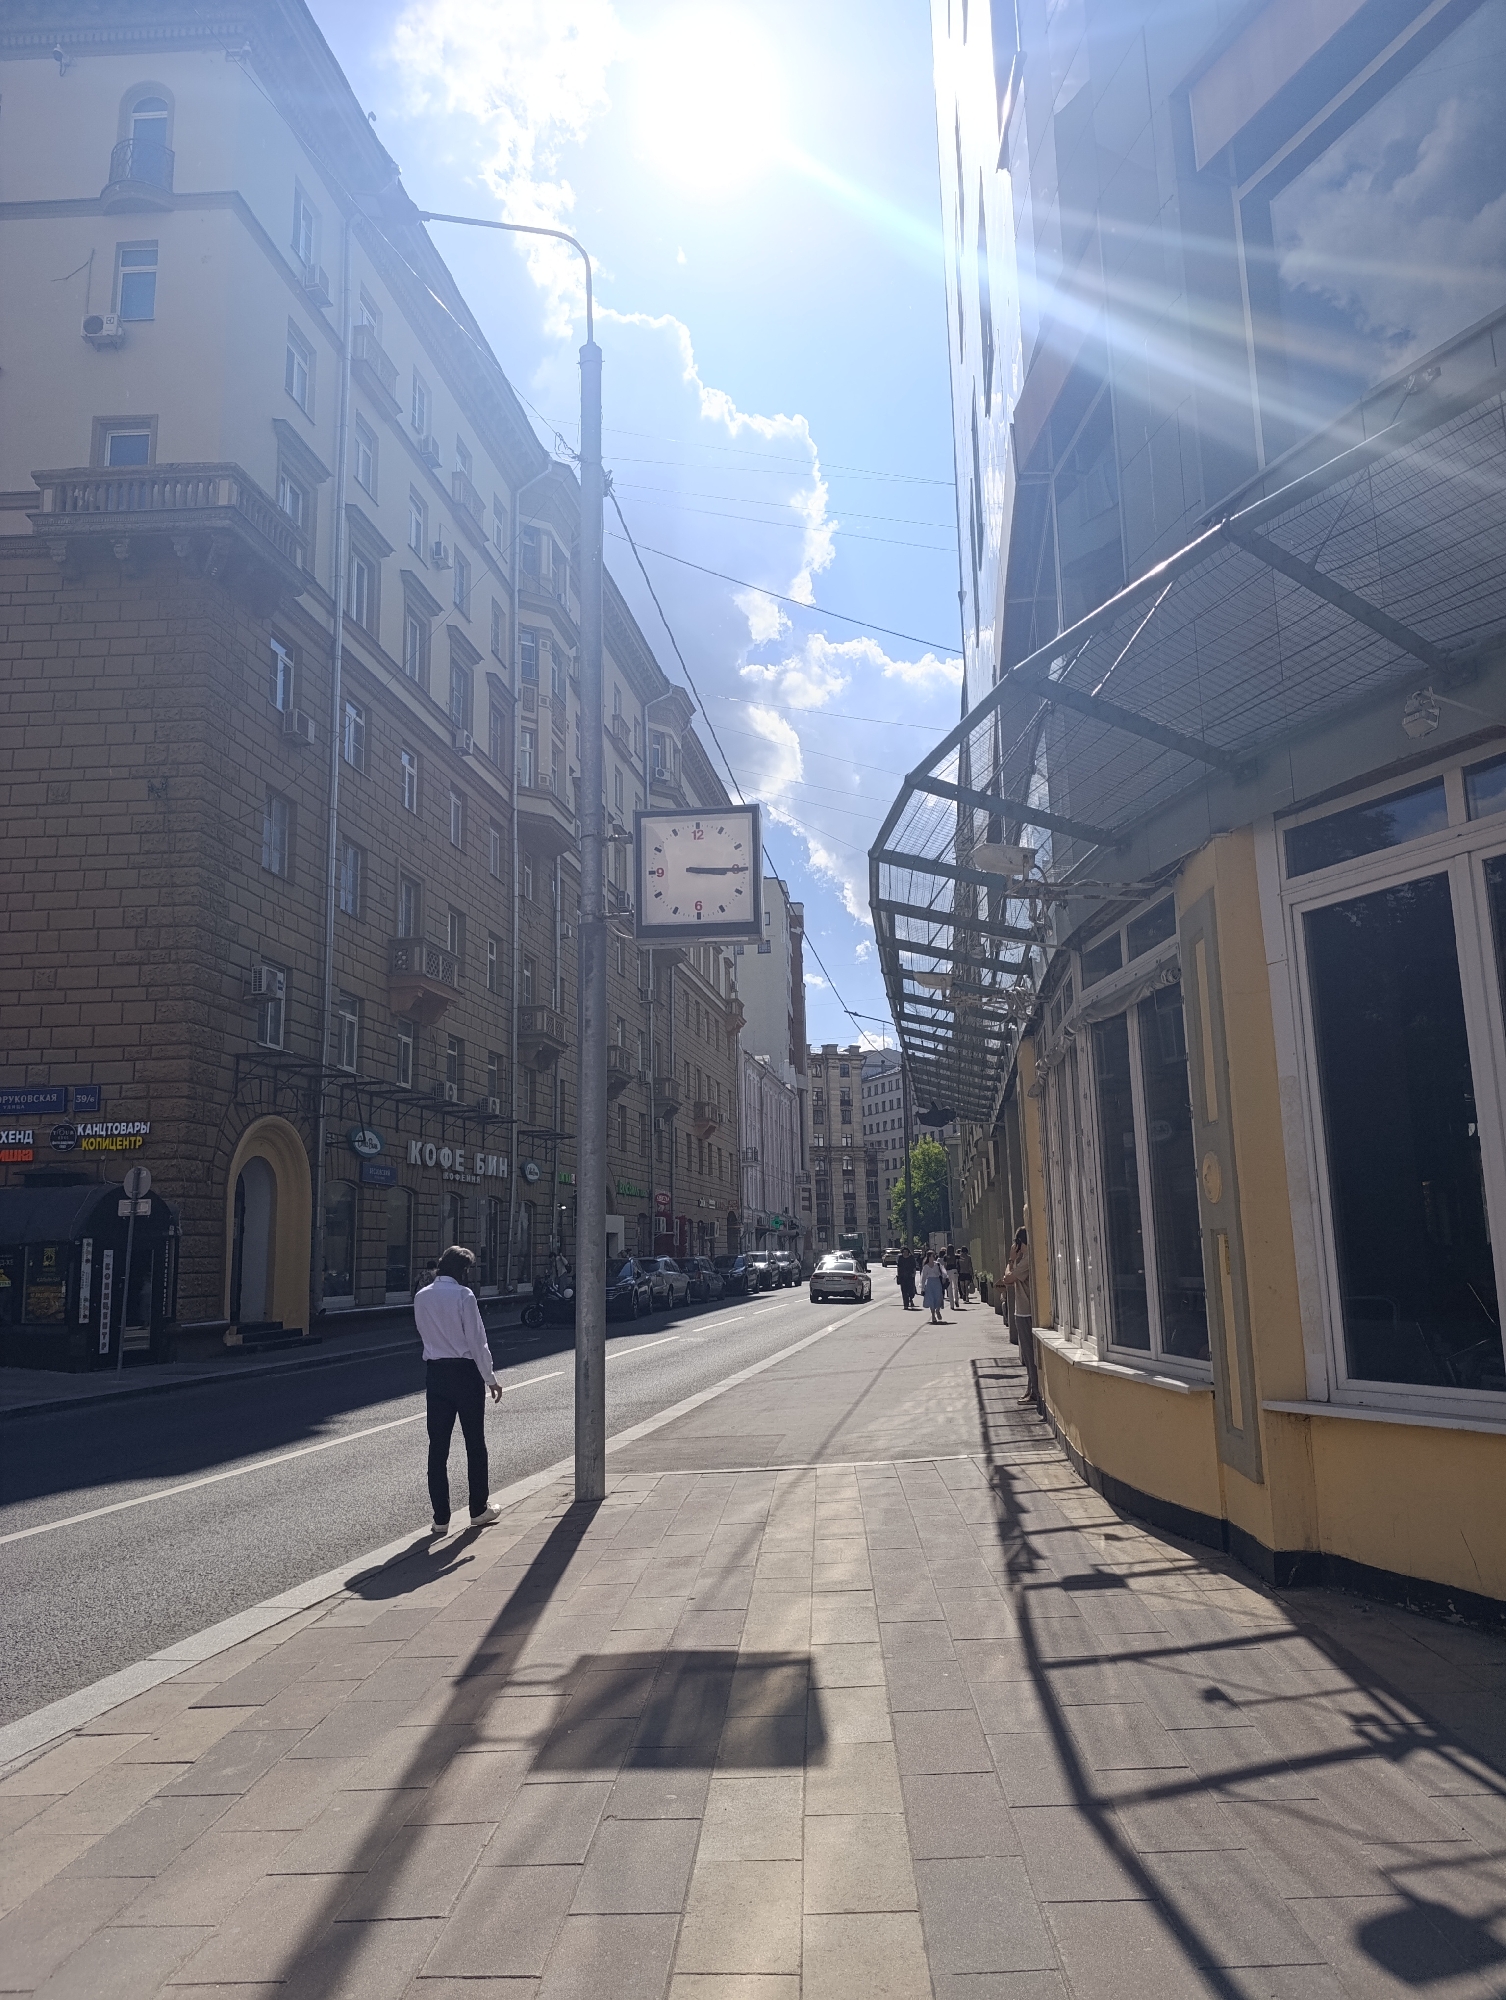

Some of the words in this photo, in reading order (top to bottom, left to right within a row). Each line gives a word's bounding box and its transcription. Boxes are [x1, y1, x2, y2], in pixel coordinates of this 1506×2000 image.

[691, 829, 704, 841] 12
[656, 867, 665, 878] 9
[694, 900, 703, 912] 6
[75, 1094, 95, 1104] 39/6
[77, 1121, 151, 1137] КАНЦТОВАРЫ
[0, 1129, 34, 1145] ХЕНД
[81, 1136, 143, 1151] КОПИЦЕНТР
[407, 1139, 465, 1173] КОФЕ
[473, 1152, 508, 1179] БИН
